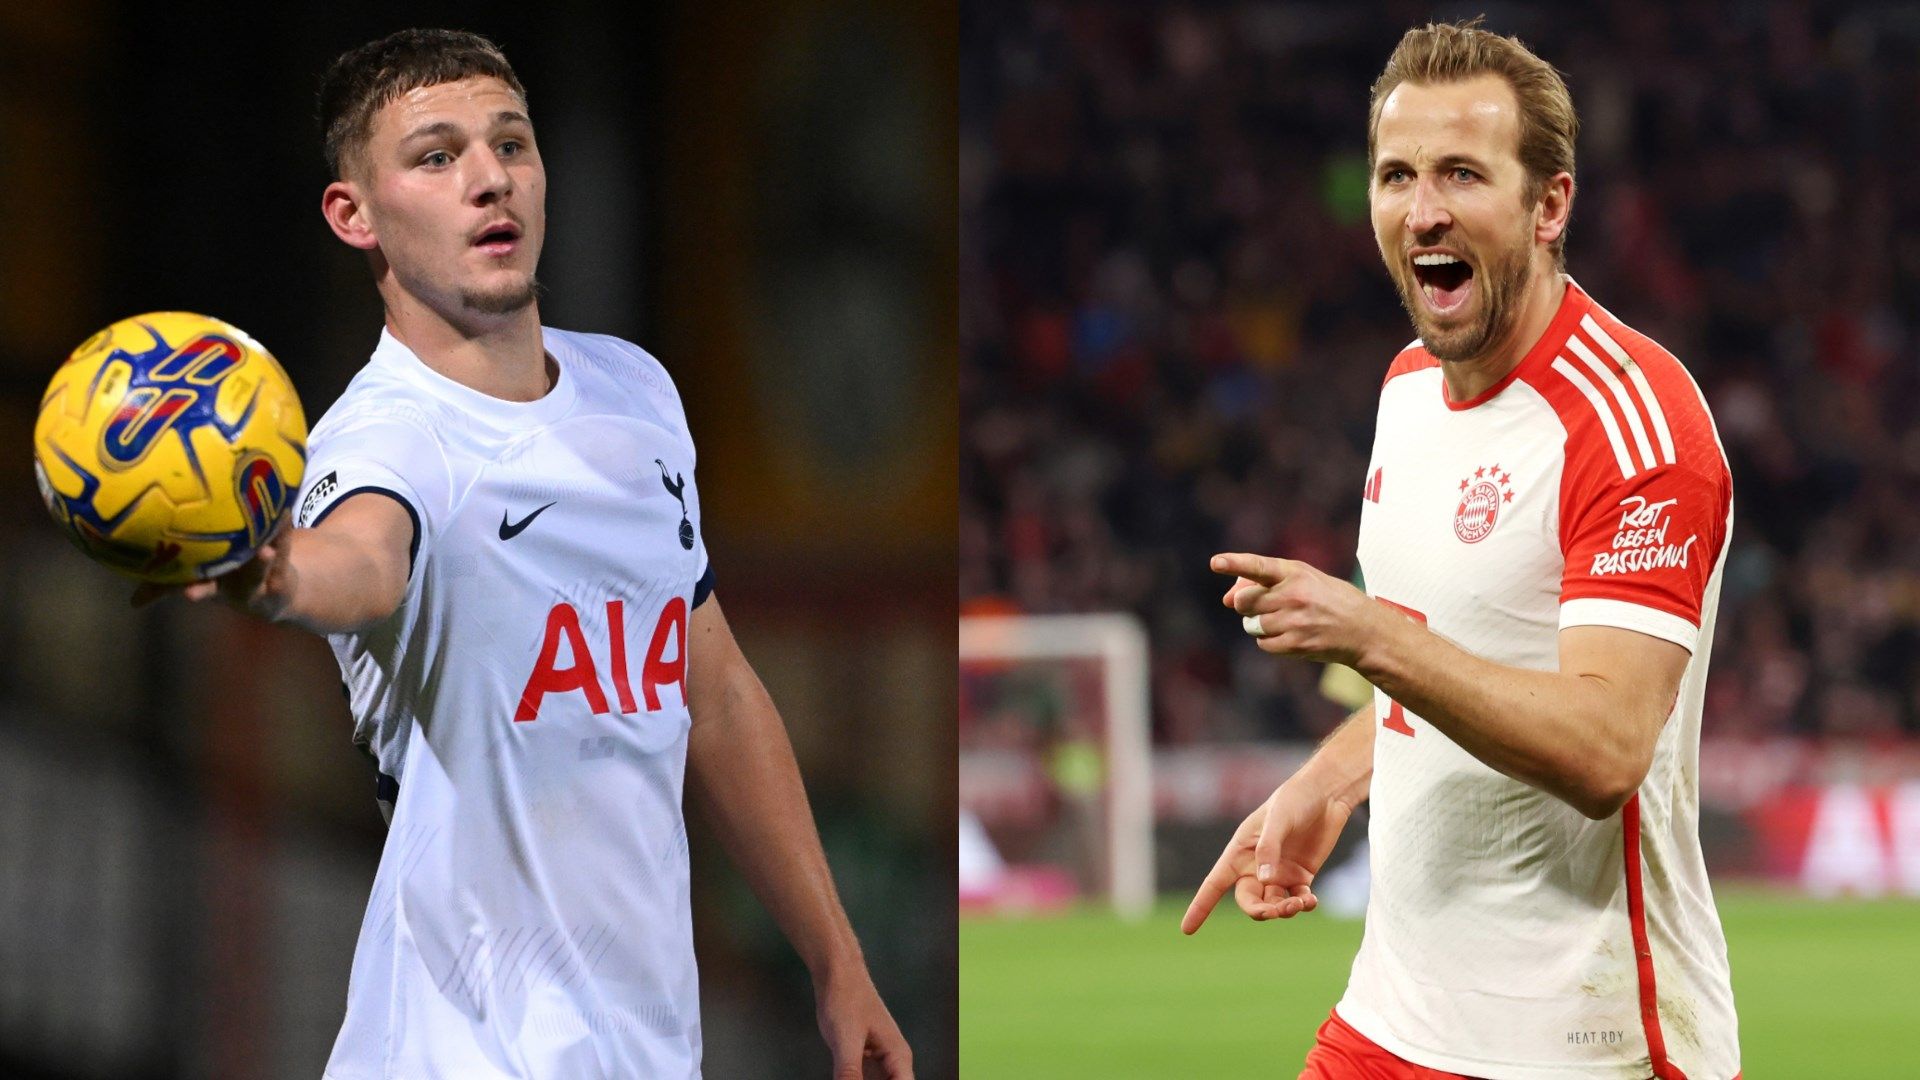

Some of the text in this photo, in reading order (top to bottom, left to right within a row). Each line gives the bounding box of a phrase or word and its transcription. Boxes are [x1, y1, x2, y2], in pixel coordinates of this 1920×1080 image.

[1619, 496, 1677, 529] ROT
[1613, 516, 1670, 549] GEGEN
[1590, 534, 1697, 576] RASSISMUS
[513, 596, 688, 722] AIA
